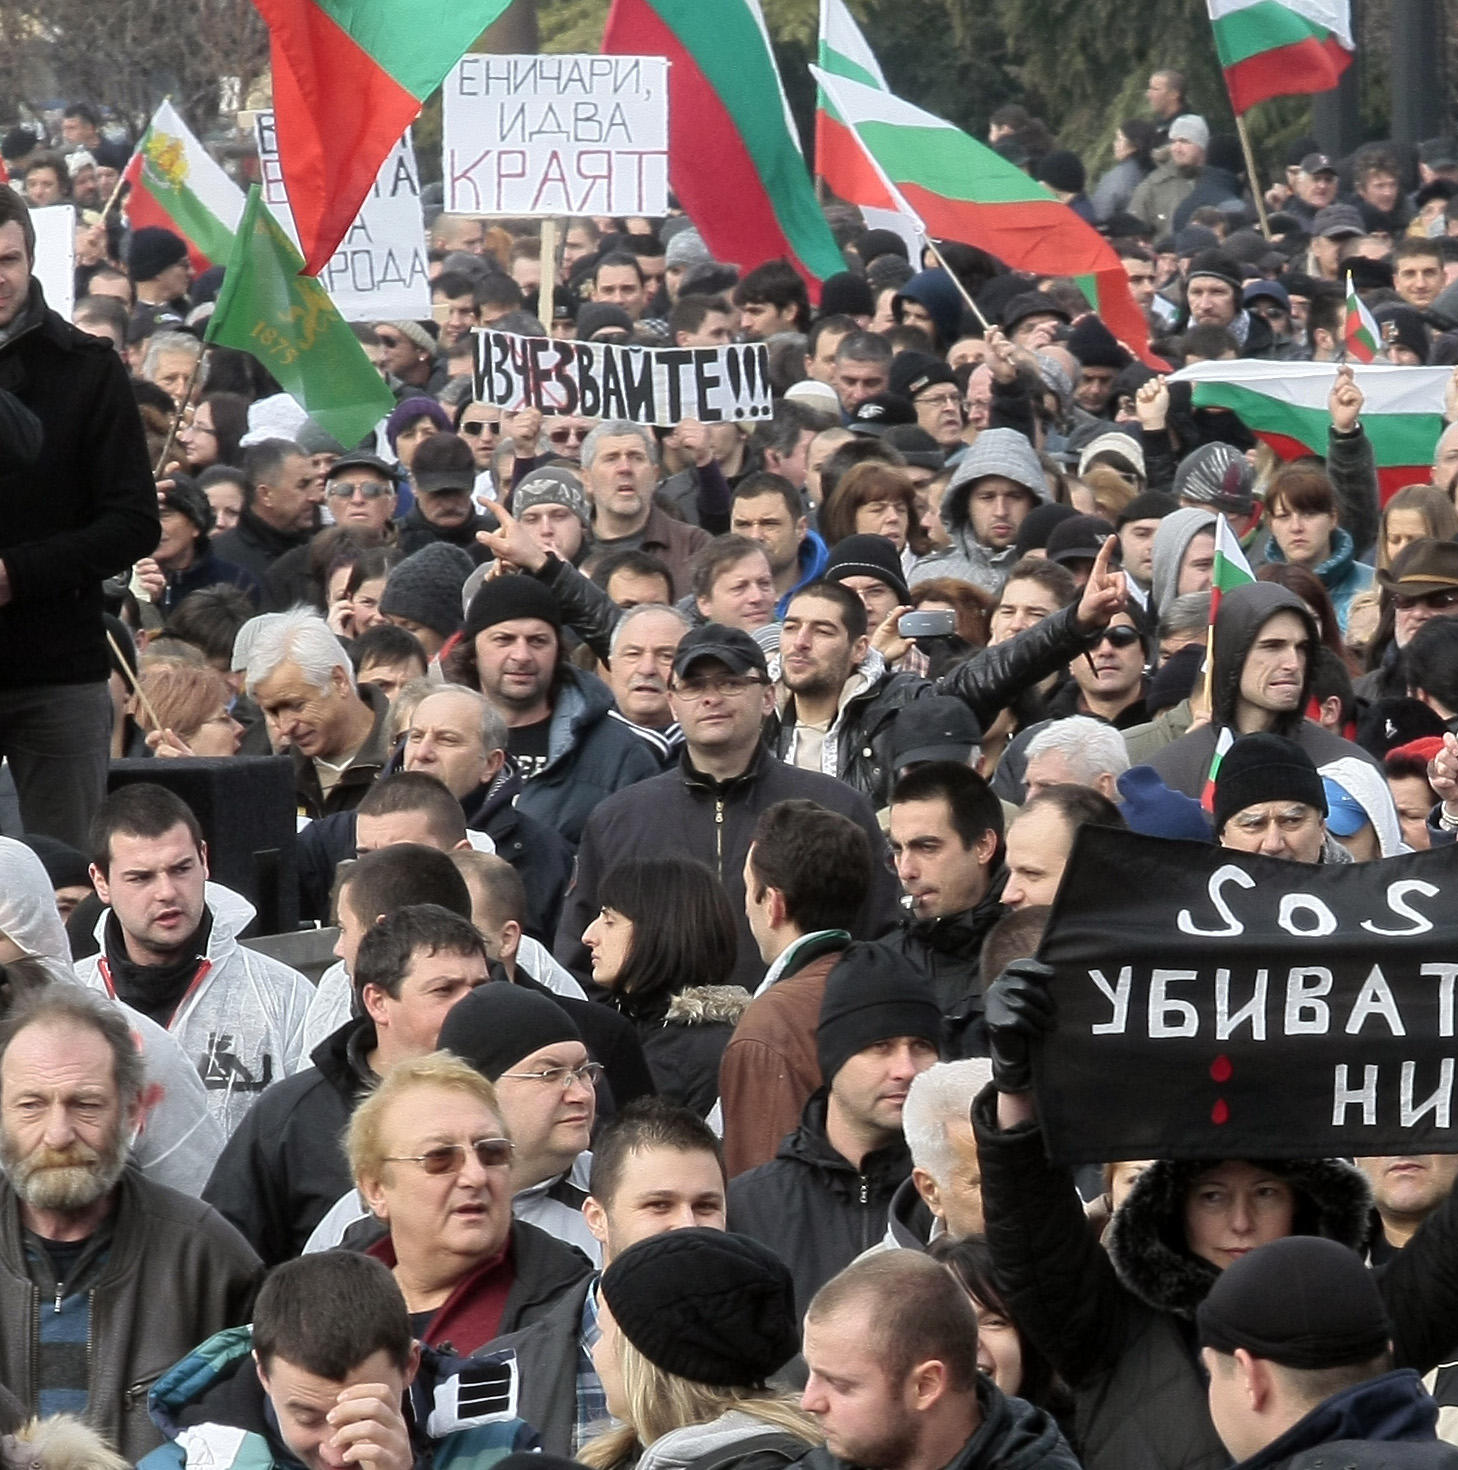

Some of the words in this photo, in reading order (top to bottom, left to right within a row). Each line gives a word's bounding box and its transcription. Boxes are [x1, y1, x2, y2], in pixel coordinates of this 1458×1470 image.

[459, 58, 651, 101] ЕНИЧАРИ,
[500, 102, 632, 143] ИДВА
[451, 149, 668, 212] КРАЯТ
[472, 331, 771, 423] ИЗЧЕЗВАЙТЕ!!!
[1177, 864, 1440, 938] SOS
